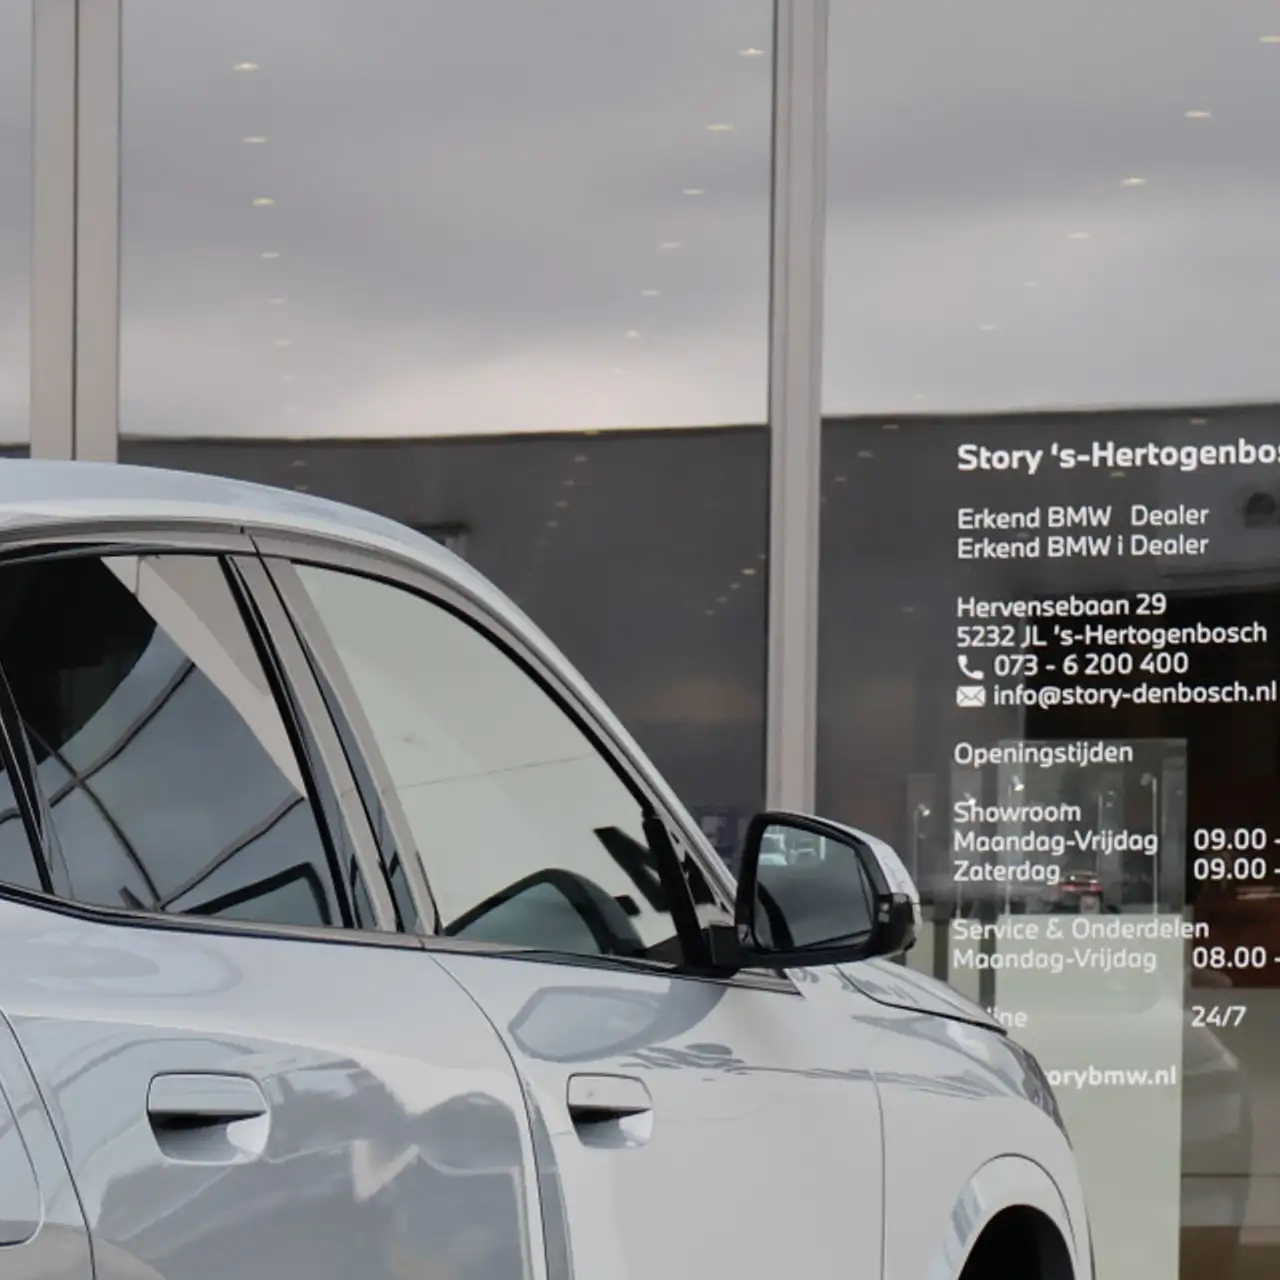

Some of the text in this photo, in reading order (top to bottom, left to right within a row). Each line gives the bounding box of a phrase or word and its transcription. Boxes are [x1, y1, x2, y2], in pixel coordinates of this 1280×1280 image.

[956, 437, 1280, 475] Story ‘s-Hertogenbo
[956, 504, 1210, 530] Erkend BMW Dealer
[956, 534, 1210, 559] Erkend BMW i Dealer
[956, 592, 1168, 618] Hervensebaan 29
[956, 621, 1268, 649] 5232 JL 's-Hertogenbosch
[993, 653, 1039, 677] 073
[1062, 653, 1079, 677] 6
[1084, 653, 1134, 676] 200
[1139, 652, 1190, 675] 400
[992, 680, 1278, 710] info@story-denbosch.nl
[953, 742, 1134, 768] Openingstijden
[952, 801, 1082, 824] Showroom
[952, 829, 1159, 856] Maandag-Vrijdag
[1193, 827, 1267, 851] 09.00
[952, 859, 1061, 884] Zaterdag
[1193, 857, 1267, 880] 09.00
[951, 916, 1210, 941] Service & Onderdelen
[951, 946, 1158, 973] Maandag-Vrijdag
[1192, 945, 1267, 969] 08.00
[1190, 1005, 1247, 1029] 24/7
[1043, 1064, 1177, 1090] orybmw.nl
